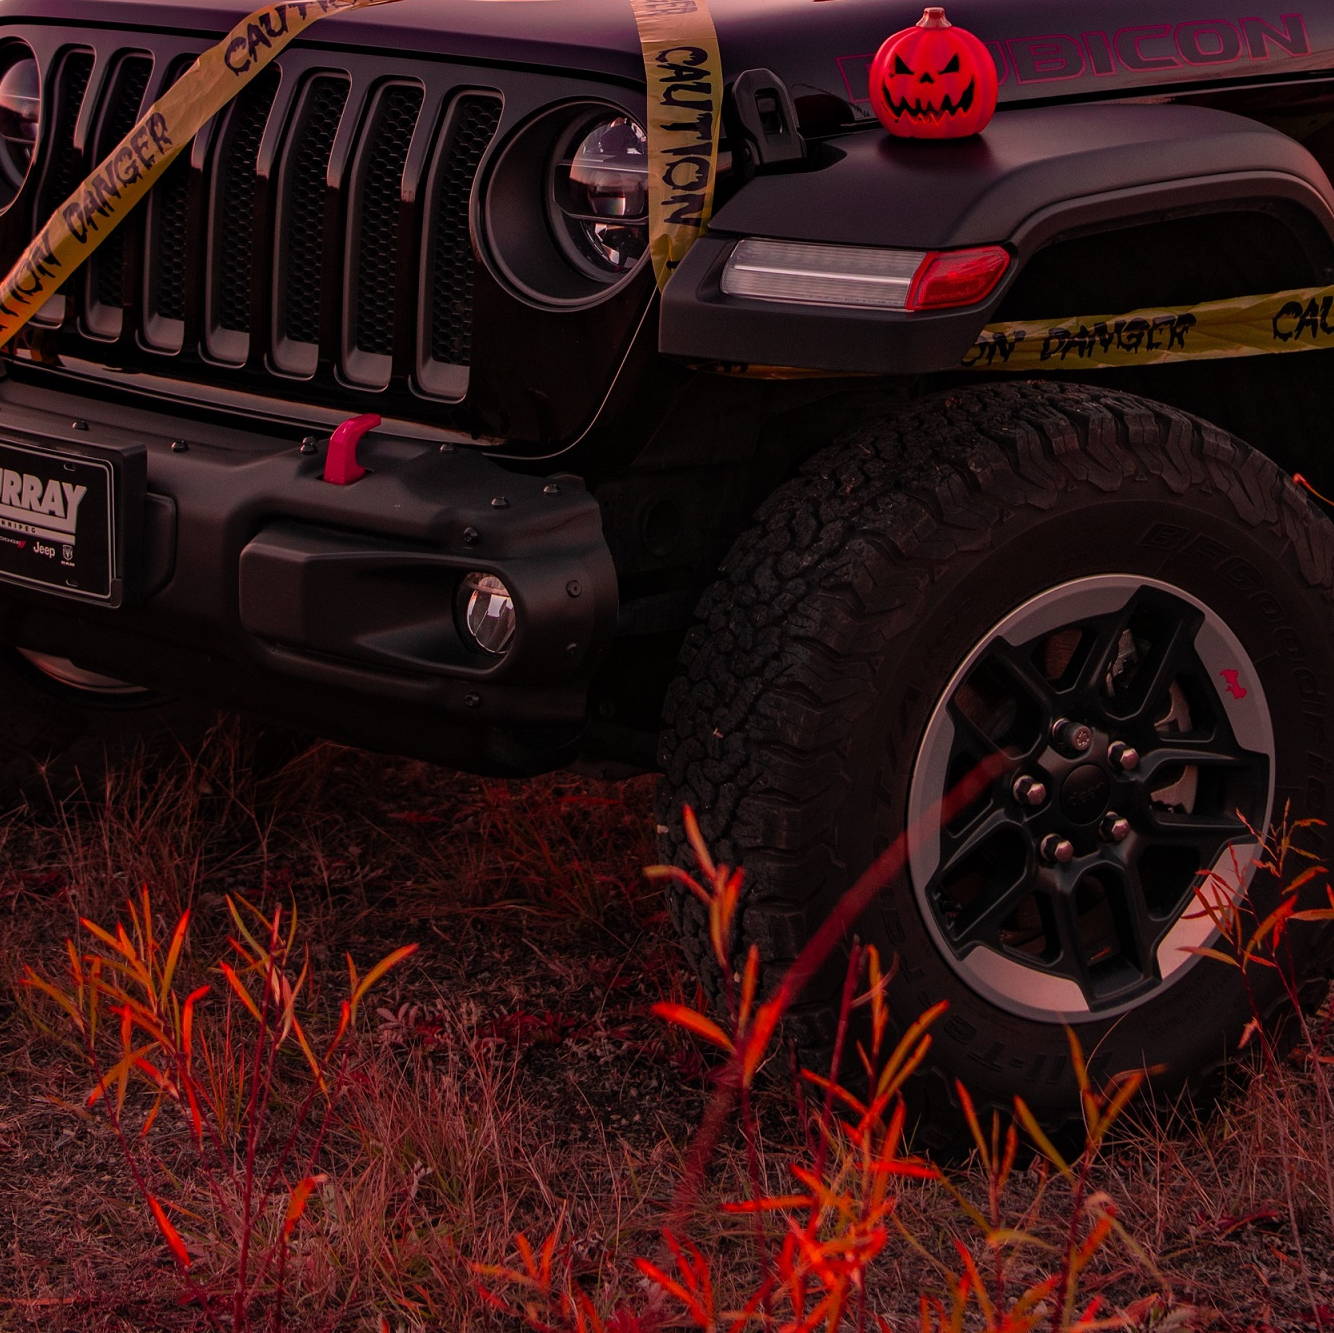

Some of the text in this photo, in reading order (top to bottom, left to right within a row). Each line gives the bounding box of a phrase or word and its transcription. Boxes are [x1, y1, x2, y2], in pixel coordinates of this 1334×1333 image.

[835, 13, 1314, 105] BICON
[62, 111, 173, 244] DANGER
[655, 46, 713, 228] CAUTION
[1040, 313, 1197, 361] DANGER
[33, 541, 56, 559] Jeep
